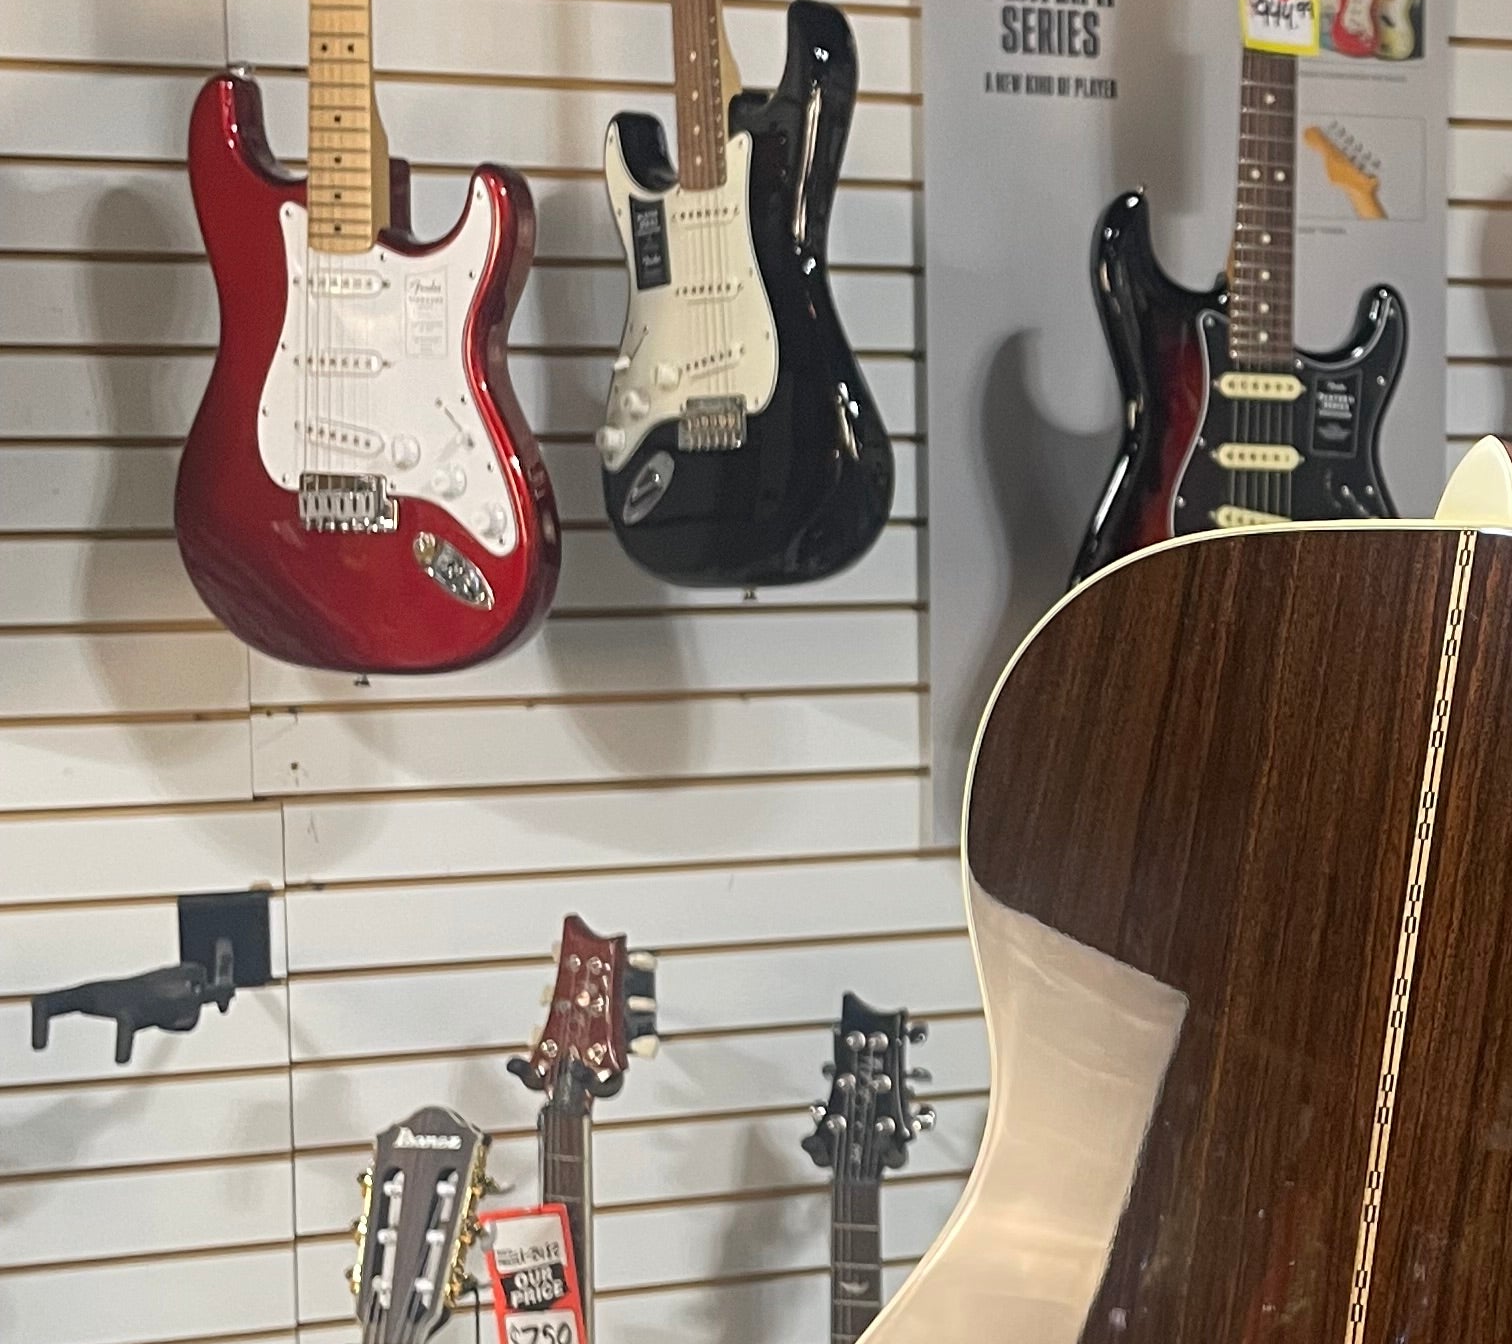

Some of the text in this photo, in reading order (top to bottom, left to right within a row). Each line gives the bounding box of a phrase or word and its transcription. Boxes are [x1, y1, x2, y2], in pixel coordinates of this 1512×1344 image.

[1001, 6, 1100, 60] SERIES
[996, 72, 1022, 94] NEW
[1074, 77, 1118, 100] PLAYER
[514, 1265, 554, 1291] OUR
[510, 1278, 565, 1310] PRICE
